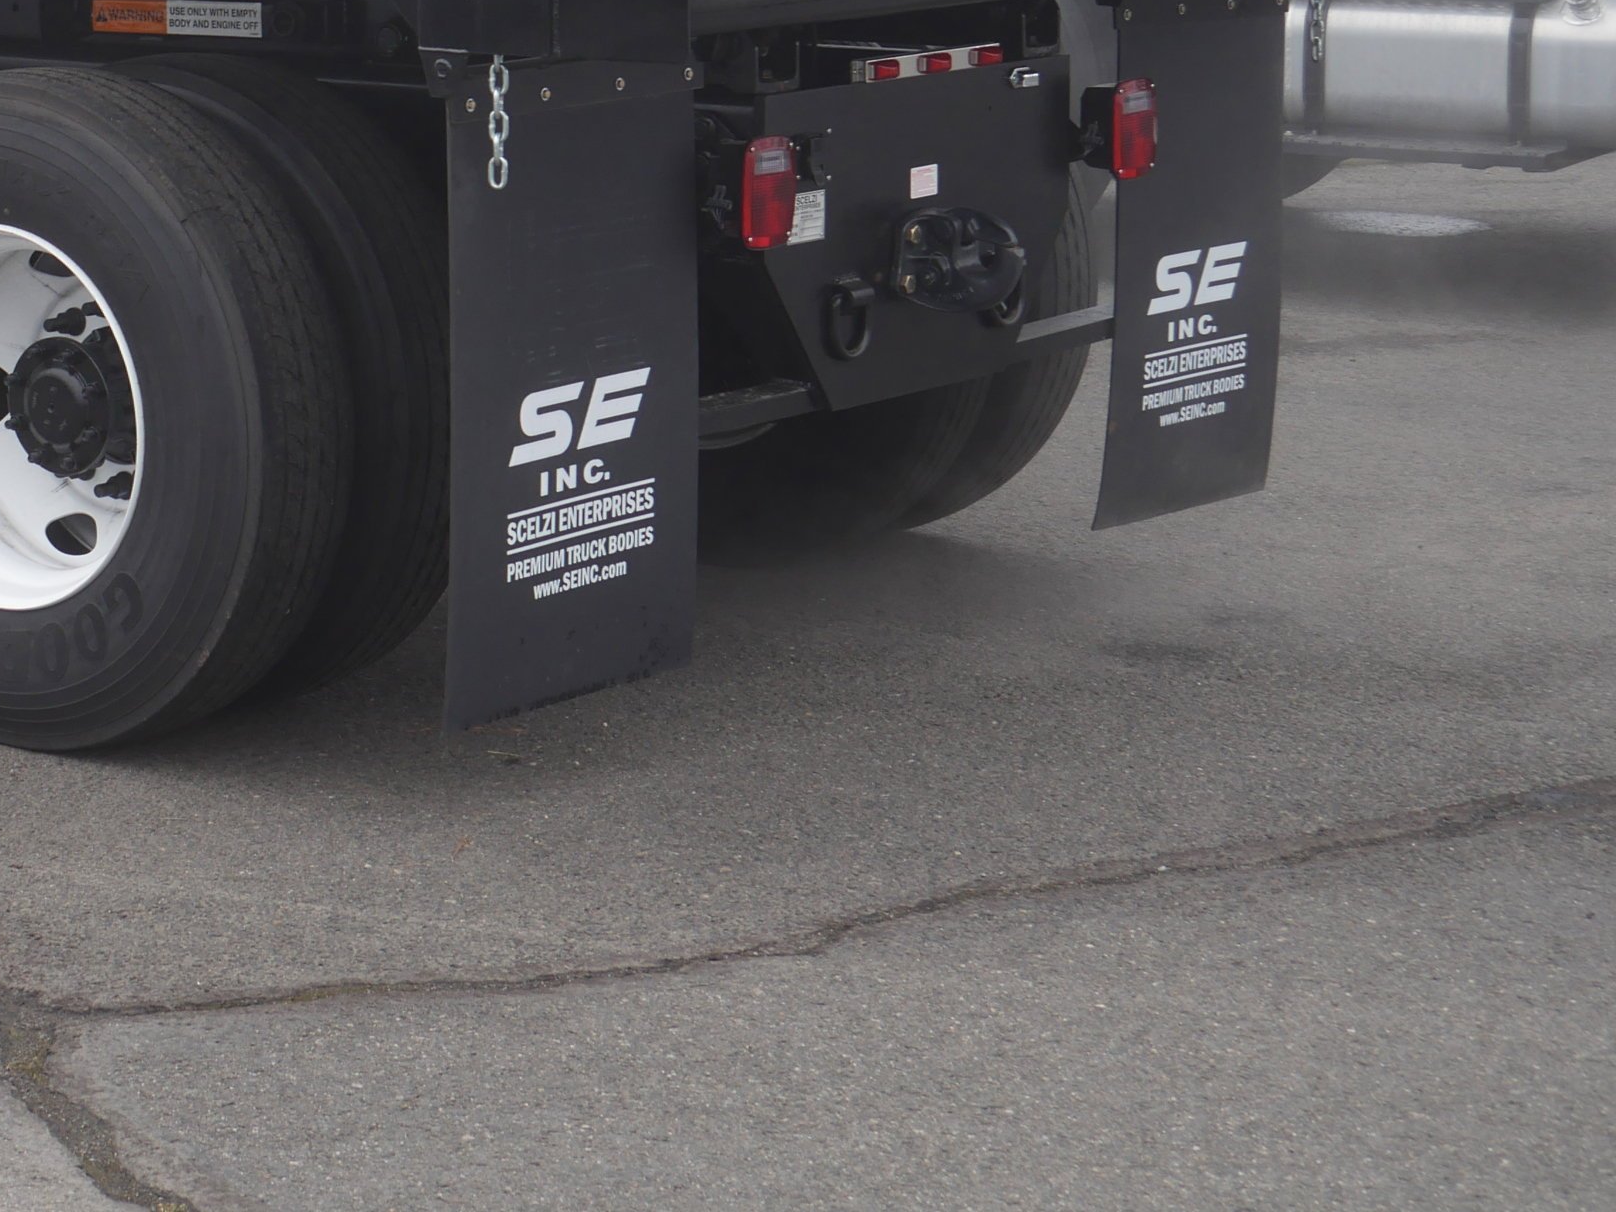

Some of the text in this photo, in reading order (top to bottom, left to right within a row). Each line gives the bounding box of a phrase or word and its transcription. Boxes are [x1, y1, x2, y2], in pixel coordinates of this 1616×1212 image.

[108, 8, 164, 23] WARNING
[169, 7, 258, 18] USE ONLY WITH EMPTY
[169, 19, 259, 31] BODY AND ENGINE OFF
[1147, 240, 1248, 316] SE
[1167, 314, 1217, 342] INC.
[1143, 341, 1247, 381] SCELZI ENTERPRISES
[1142, 373, 1245, 412] PREMIUM TRUCK BODIES
[508, 366, 651, 468] SE
[1159, 400, 1226, 428] www.SEINC.com
[539, 458, 611, 497] INC.
[507, 487, 654, 546] SCELZI ENTERPRISES
[506, 526, 654, 583] PREMIUM TRUCK BODIES
[533, 564, 627, 600] www.SEINC.com
